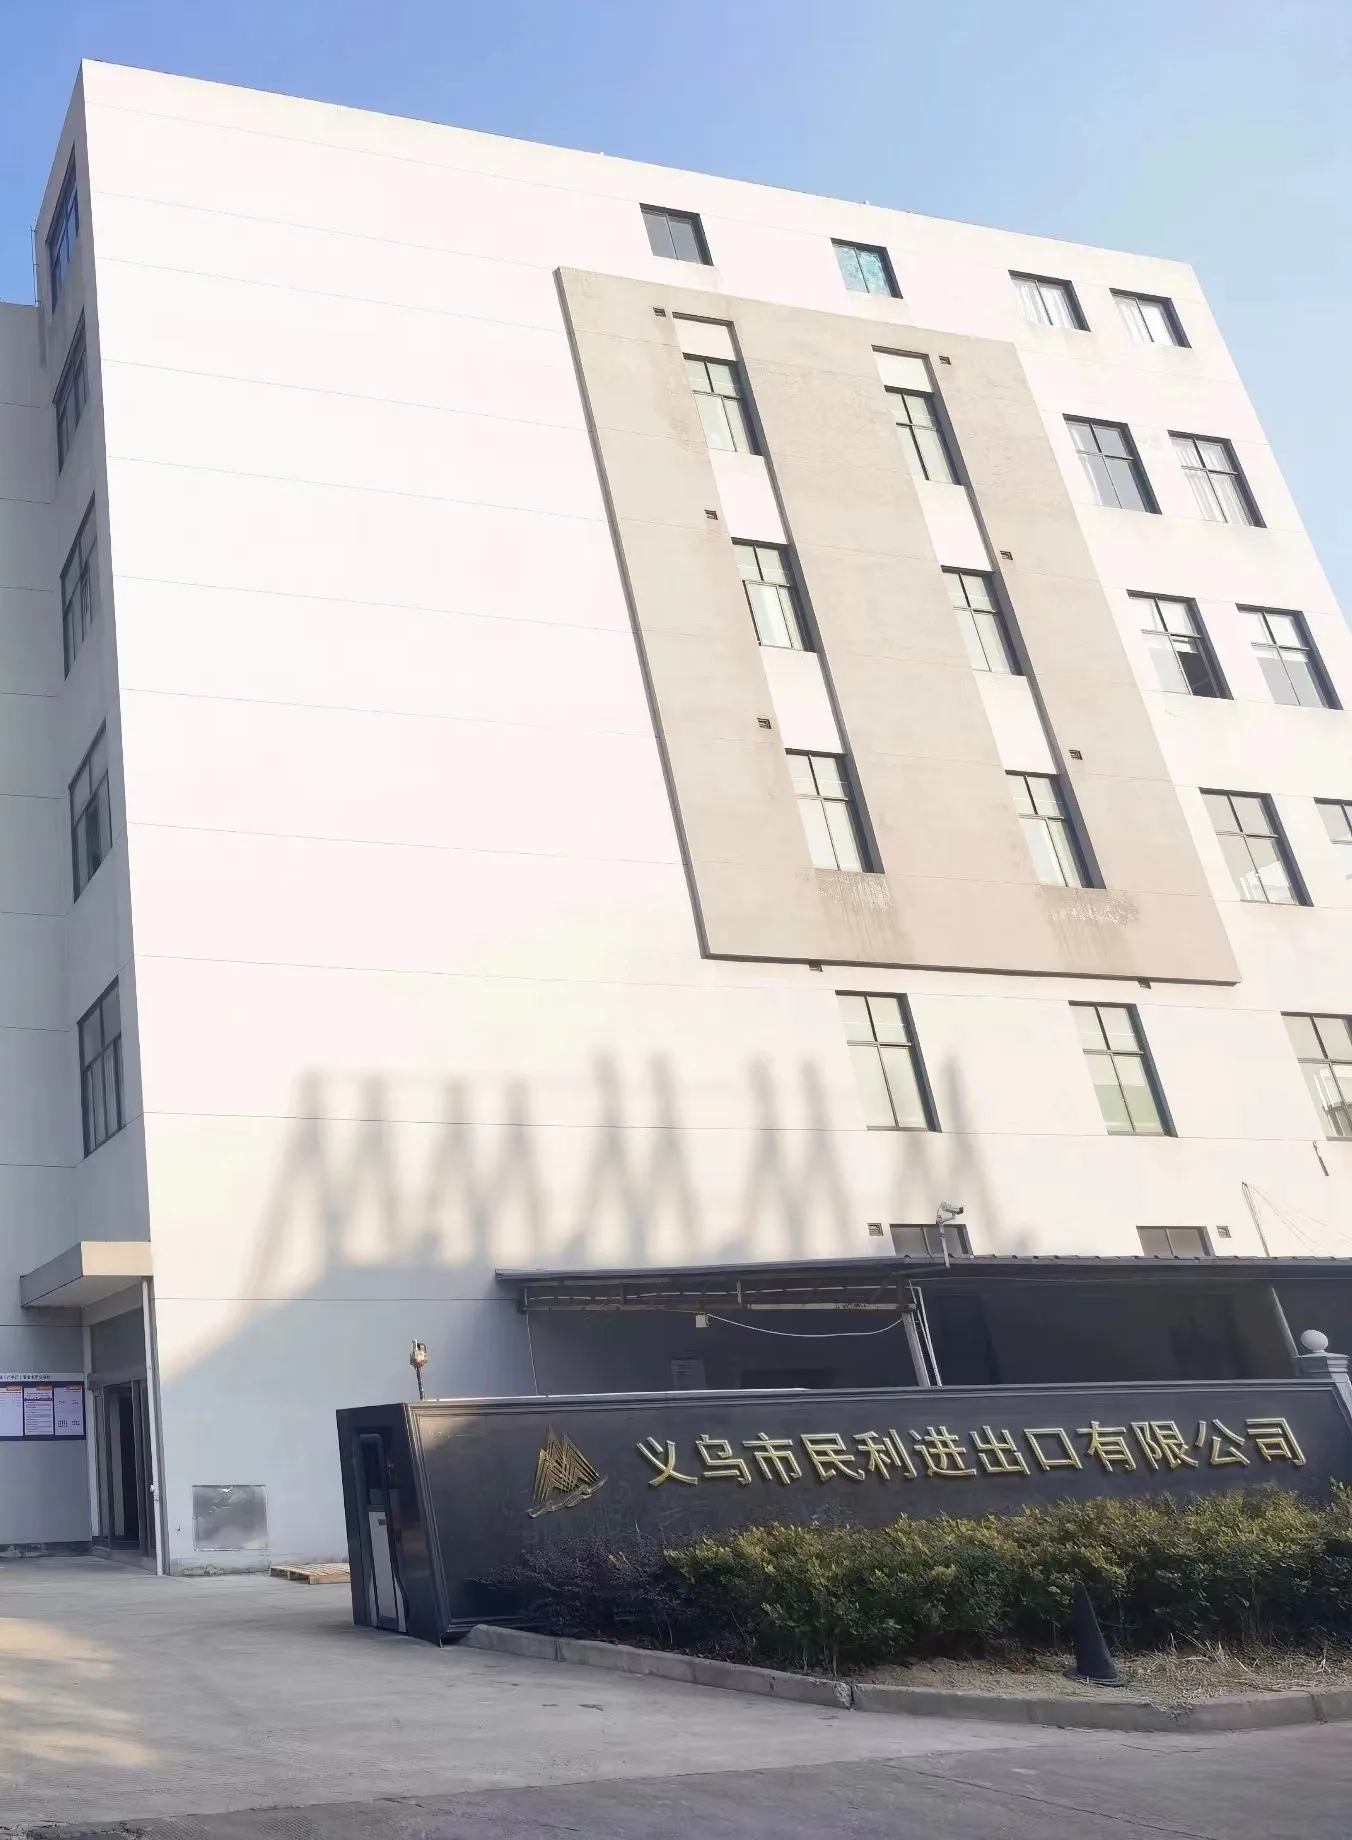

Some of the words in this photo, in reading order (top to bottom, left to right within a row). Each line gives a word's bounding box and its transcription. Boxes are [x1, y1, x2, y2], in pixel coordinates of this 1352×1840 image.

[636, 1416, 1308, 1488] 义乌市民利进出口有限公司
